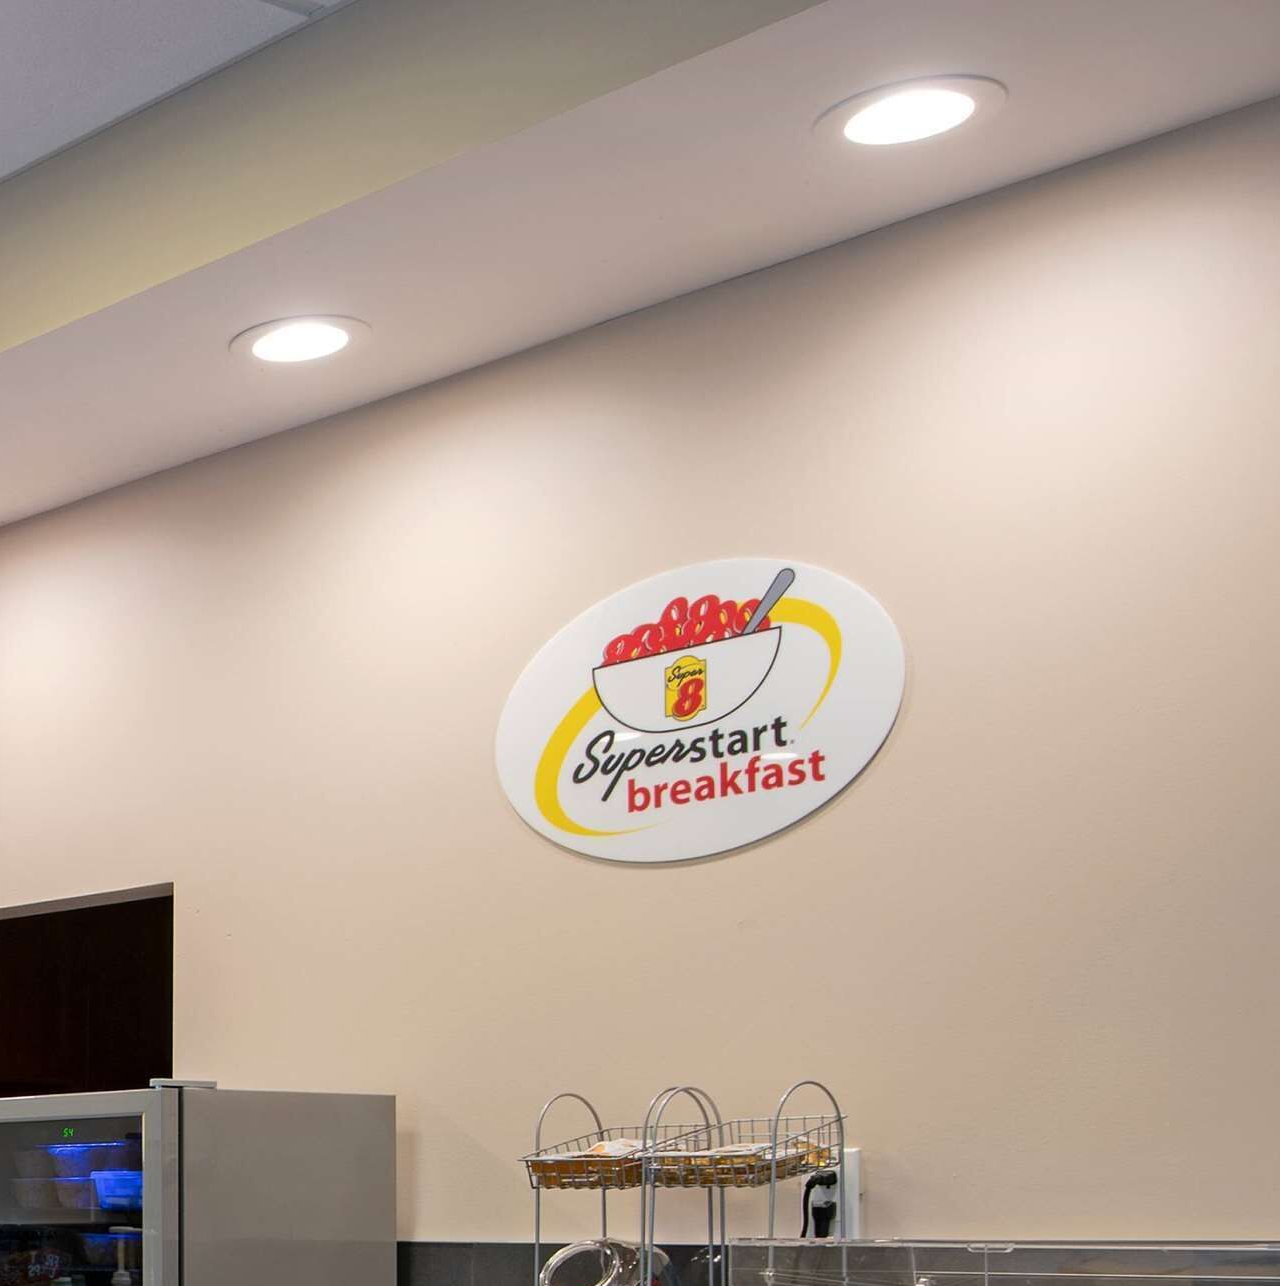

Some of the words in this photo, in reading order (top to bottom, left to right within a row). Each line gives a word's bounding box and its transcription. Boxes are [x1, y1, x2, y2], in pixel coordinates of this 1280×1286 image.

[667, 666, 705, 686] Super
[672, 678, 704, 717] 8
[572, 715, 788, 802] Superstart
[627, 749, 826, 813] breakfast
